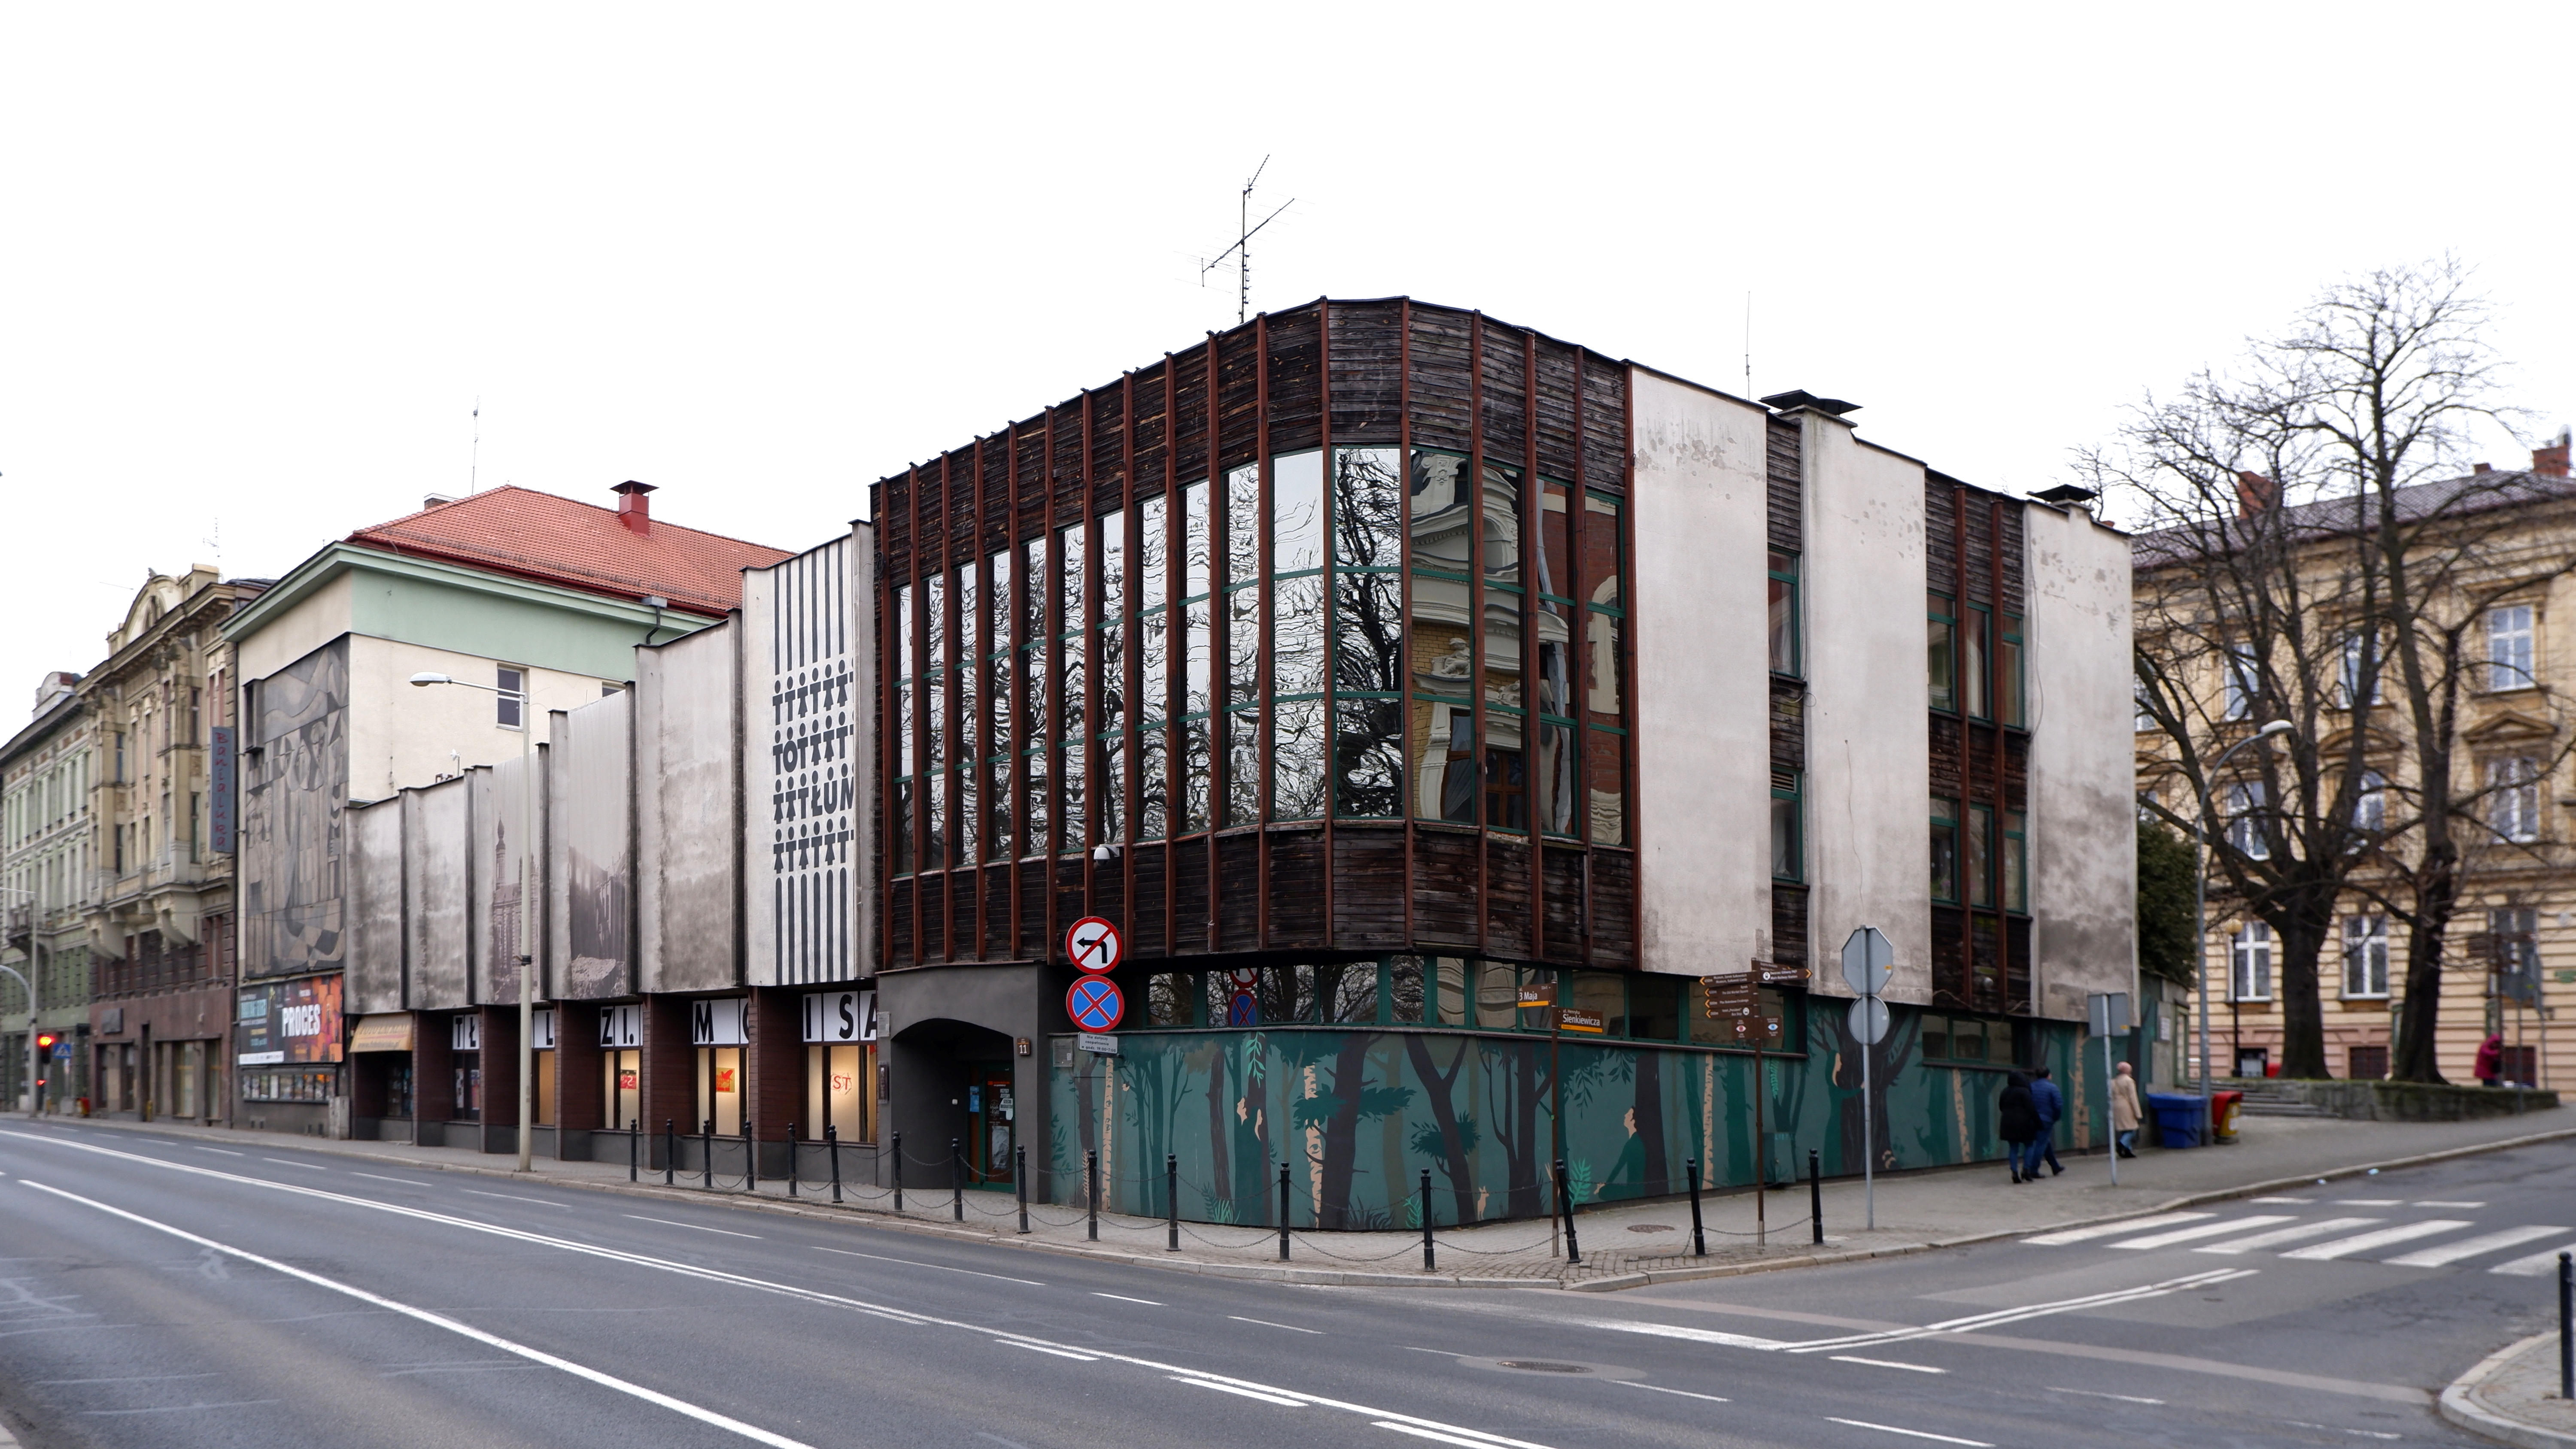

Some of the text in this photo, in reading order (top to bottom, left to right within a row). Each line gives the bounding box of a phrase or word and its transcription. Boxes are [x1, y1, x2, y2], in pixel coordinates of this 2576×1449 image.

[1519, 991, 1538, 1002] 3 Maja
[282, 1003, 321, 1037] PROCES
[1563, 1014, 1600, 1026] Sienkiewicza
[1019, 1044, 1027, 1054] 11
